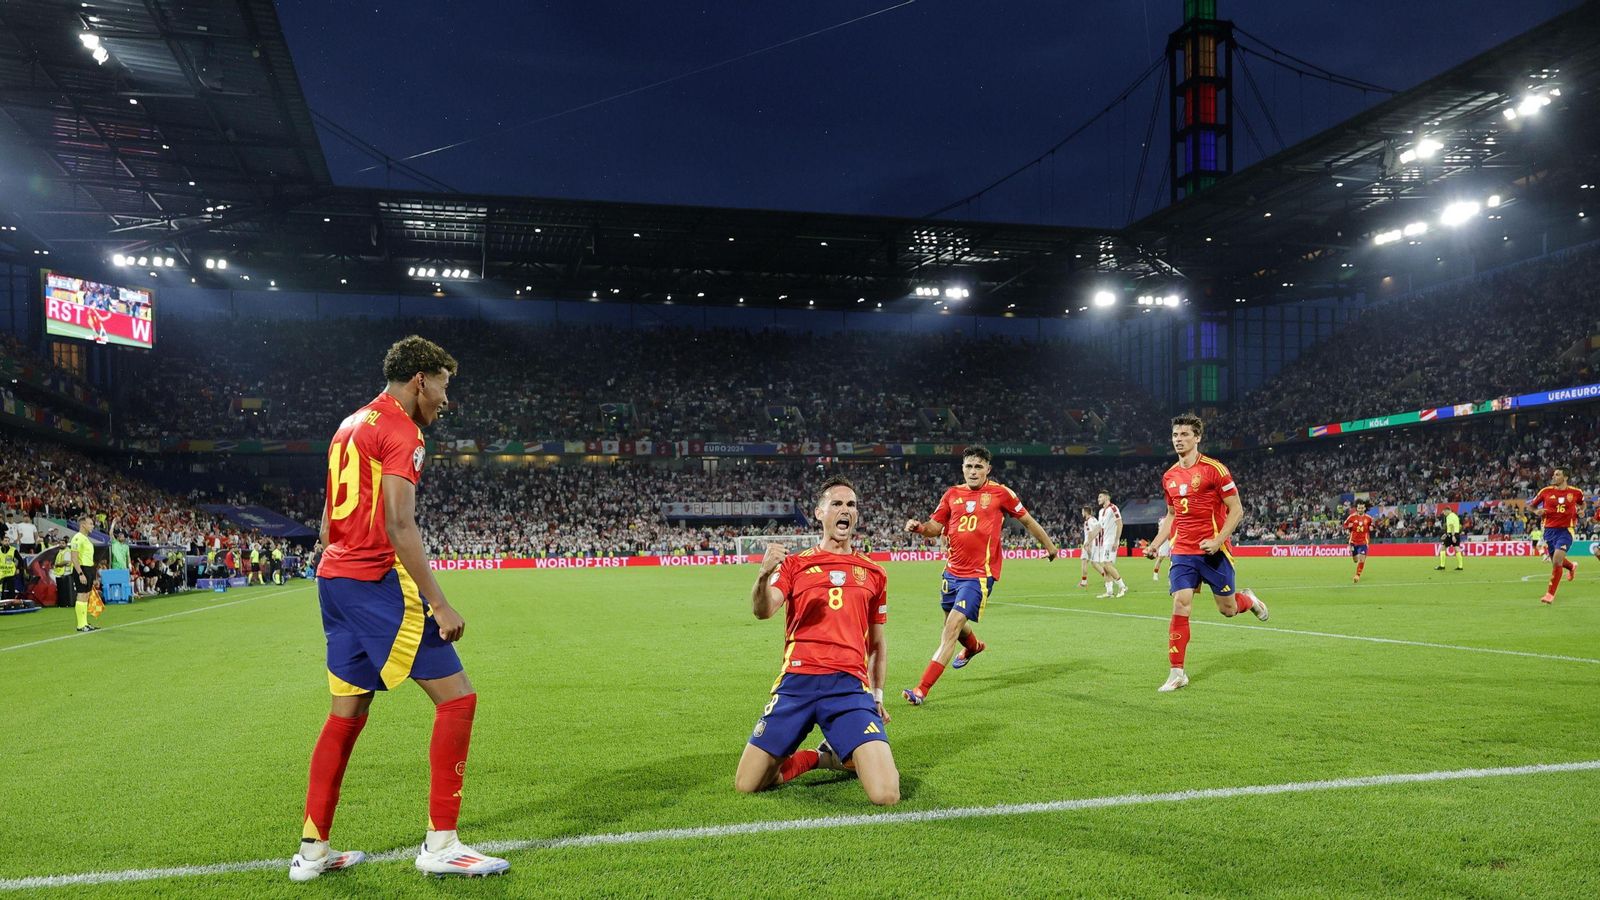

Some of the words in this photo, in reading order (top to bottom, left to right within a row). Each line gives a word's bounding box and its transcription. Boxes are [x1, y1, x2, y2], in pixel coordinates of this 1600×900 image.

[48, 299, 84, 325] RST
[1000, 446, 1023, 454] KÖLN
[693, 502, 761, 515] BELIEVE
[1180, 497, 1189, 514] 3
[1556, 504, 1566, 513] 16
[957, 515, 978, 532] 20
[1272, 546, 1288, 556] One
[1289, 545, 1313, 556] World
[1314, 545, 1351, 556] Account
[429, 559, 503, 570] RLDFIRST
[535, 556, 629, 568] WORLDFIRST
[828, 586, 843, 611] 8
[764, 693, 779, 716] 8
